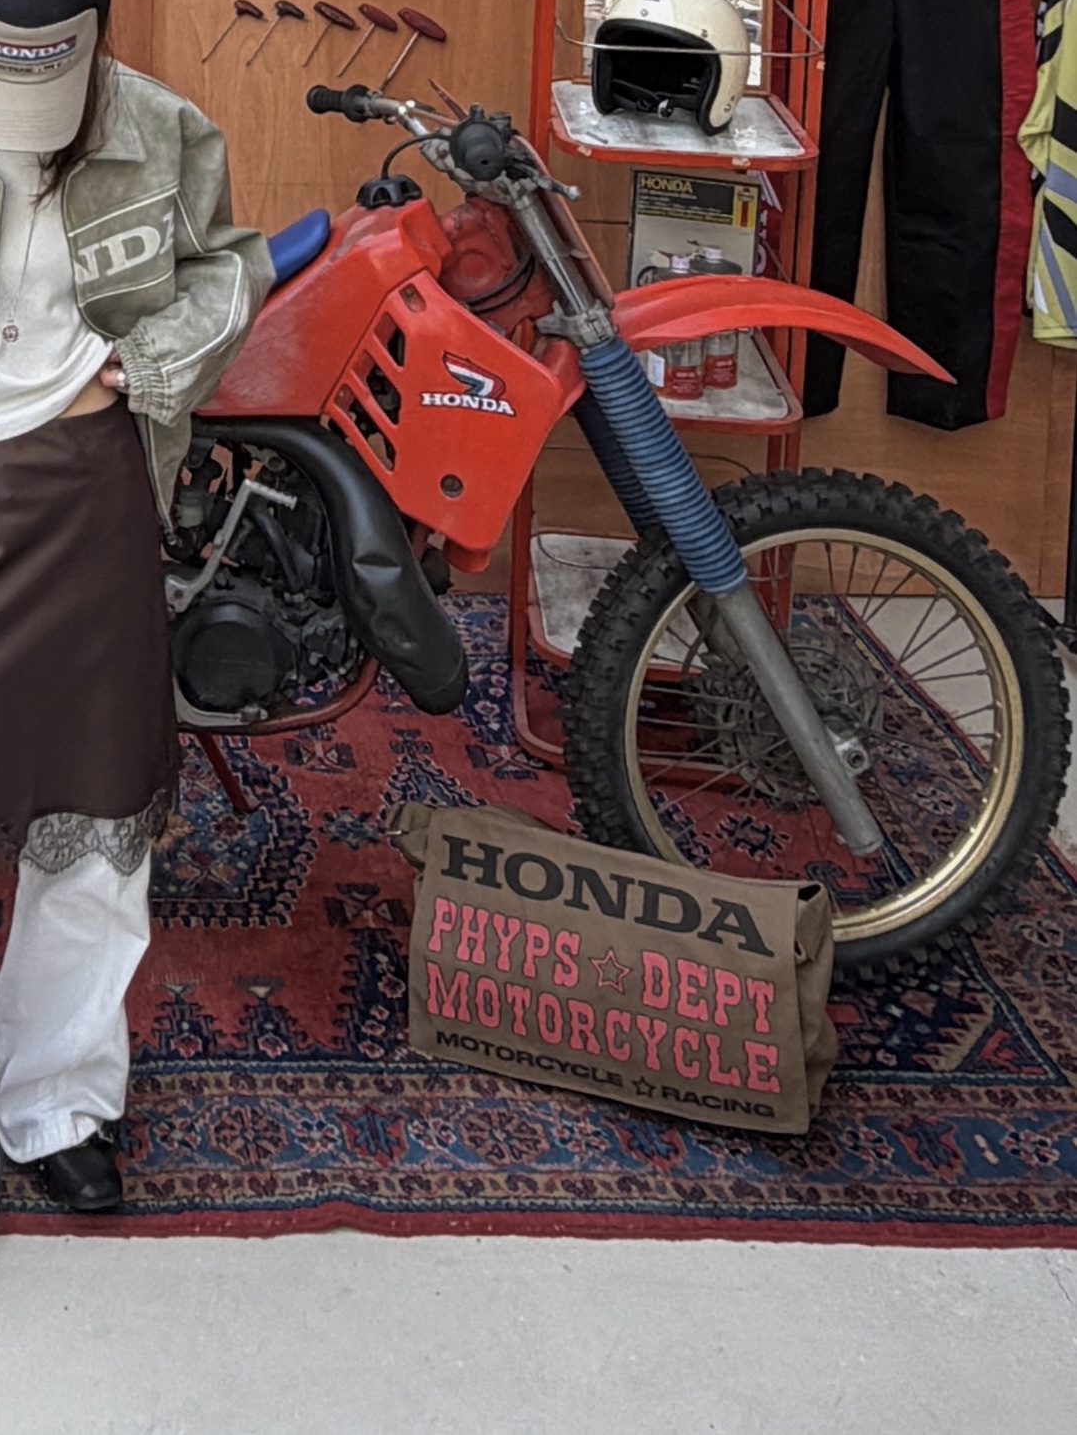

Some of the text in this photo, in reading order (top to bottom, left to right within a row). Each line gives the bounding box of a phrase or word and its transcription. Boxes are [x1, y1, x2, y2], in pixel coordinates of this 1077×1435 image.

[641, 176, 694, 194] HONDA
[421, 392, 516, 417] HONDA
[441, 834, 775, 958] HONDA
[427, 897, 776, 1035] PHYPS DEPT
[425, 961, 782, 1094] MOTORCYCLE
[436, 1031, 776, 1118] MOTORCYCLE RACING
